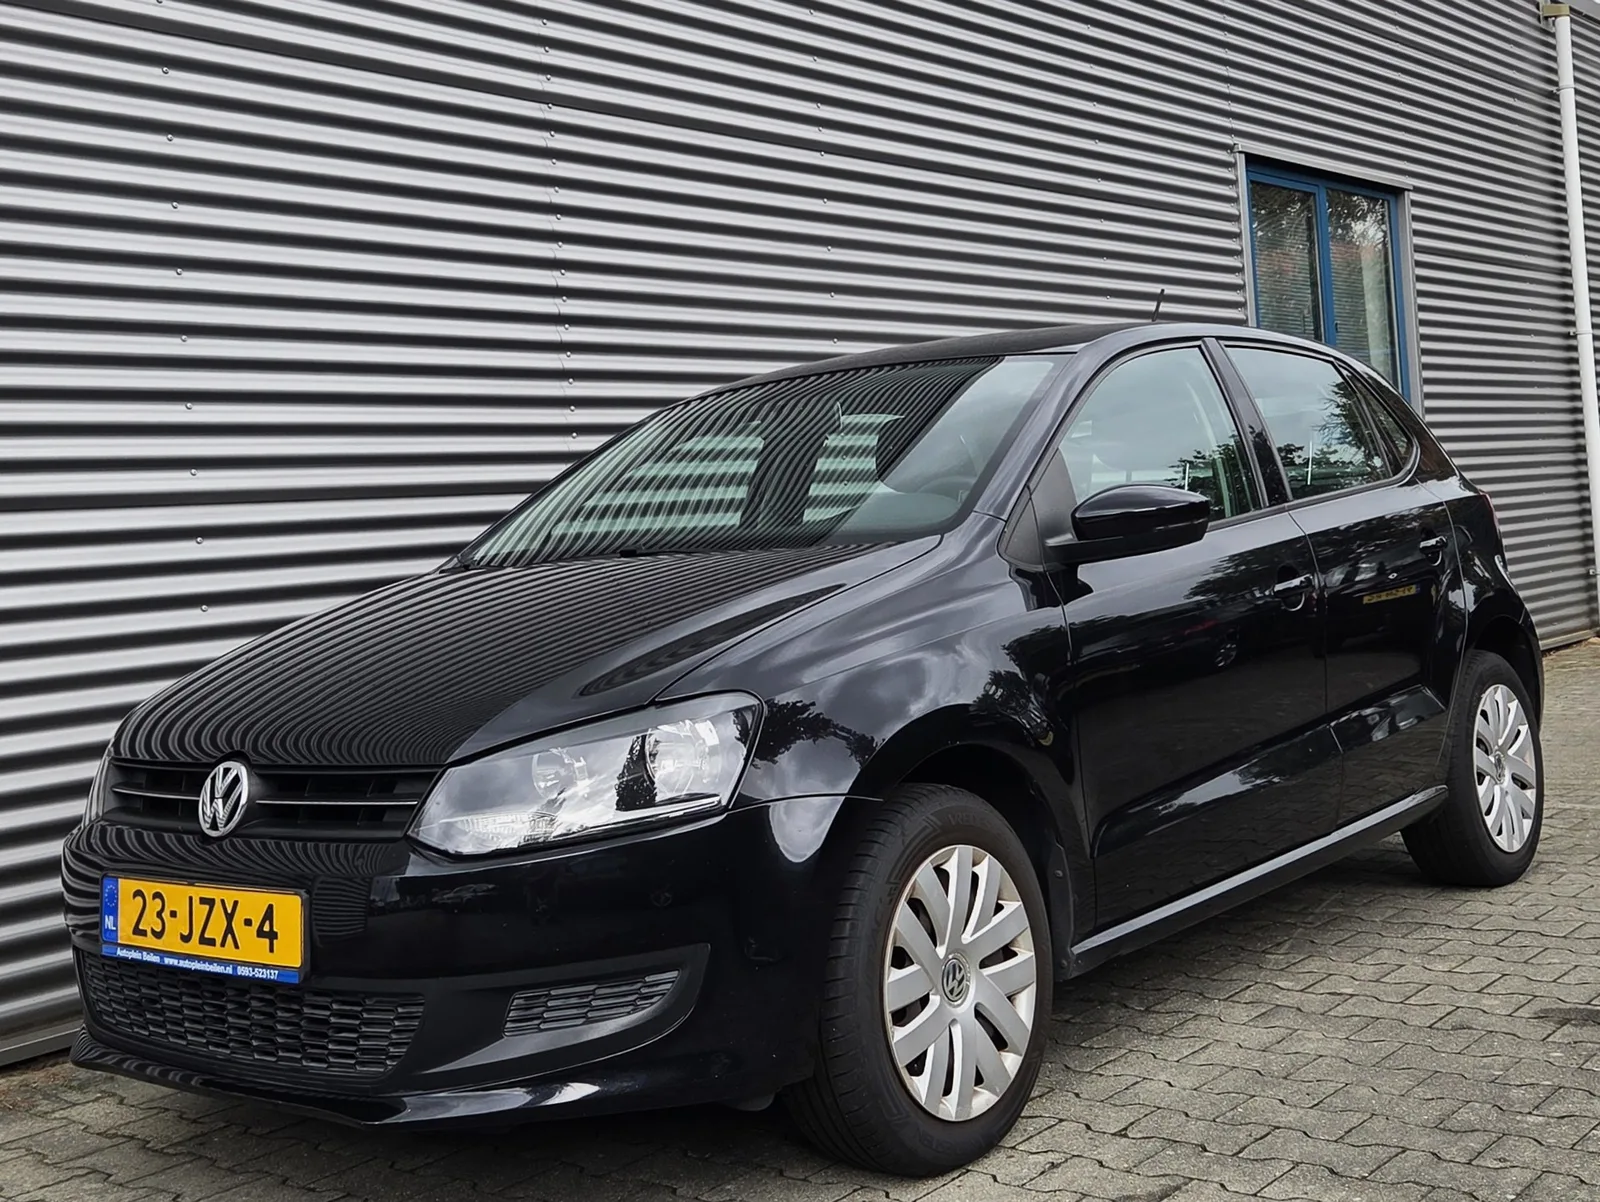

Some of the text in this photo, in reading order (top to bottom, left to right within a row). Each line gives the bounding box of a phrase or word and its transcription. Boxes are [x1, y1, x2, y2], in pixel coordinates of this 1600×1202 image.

[104, 914, 117, 930] NL
[131, 888, 279, 954] 23-JZX-4
[116, 947, 279, 980] Autoplein Beilen www.autopleinbeilen.nl 0593-523137
